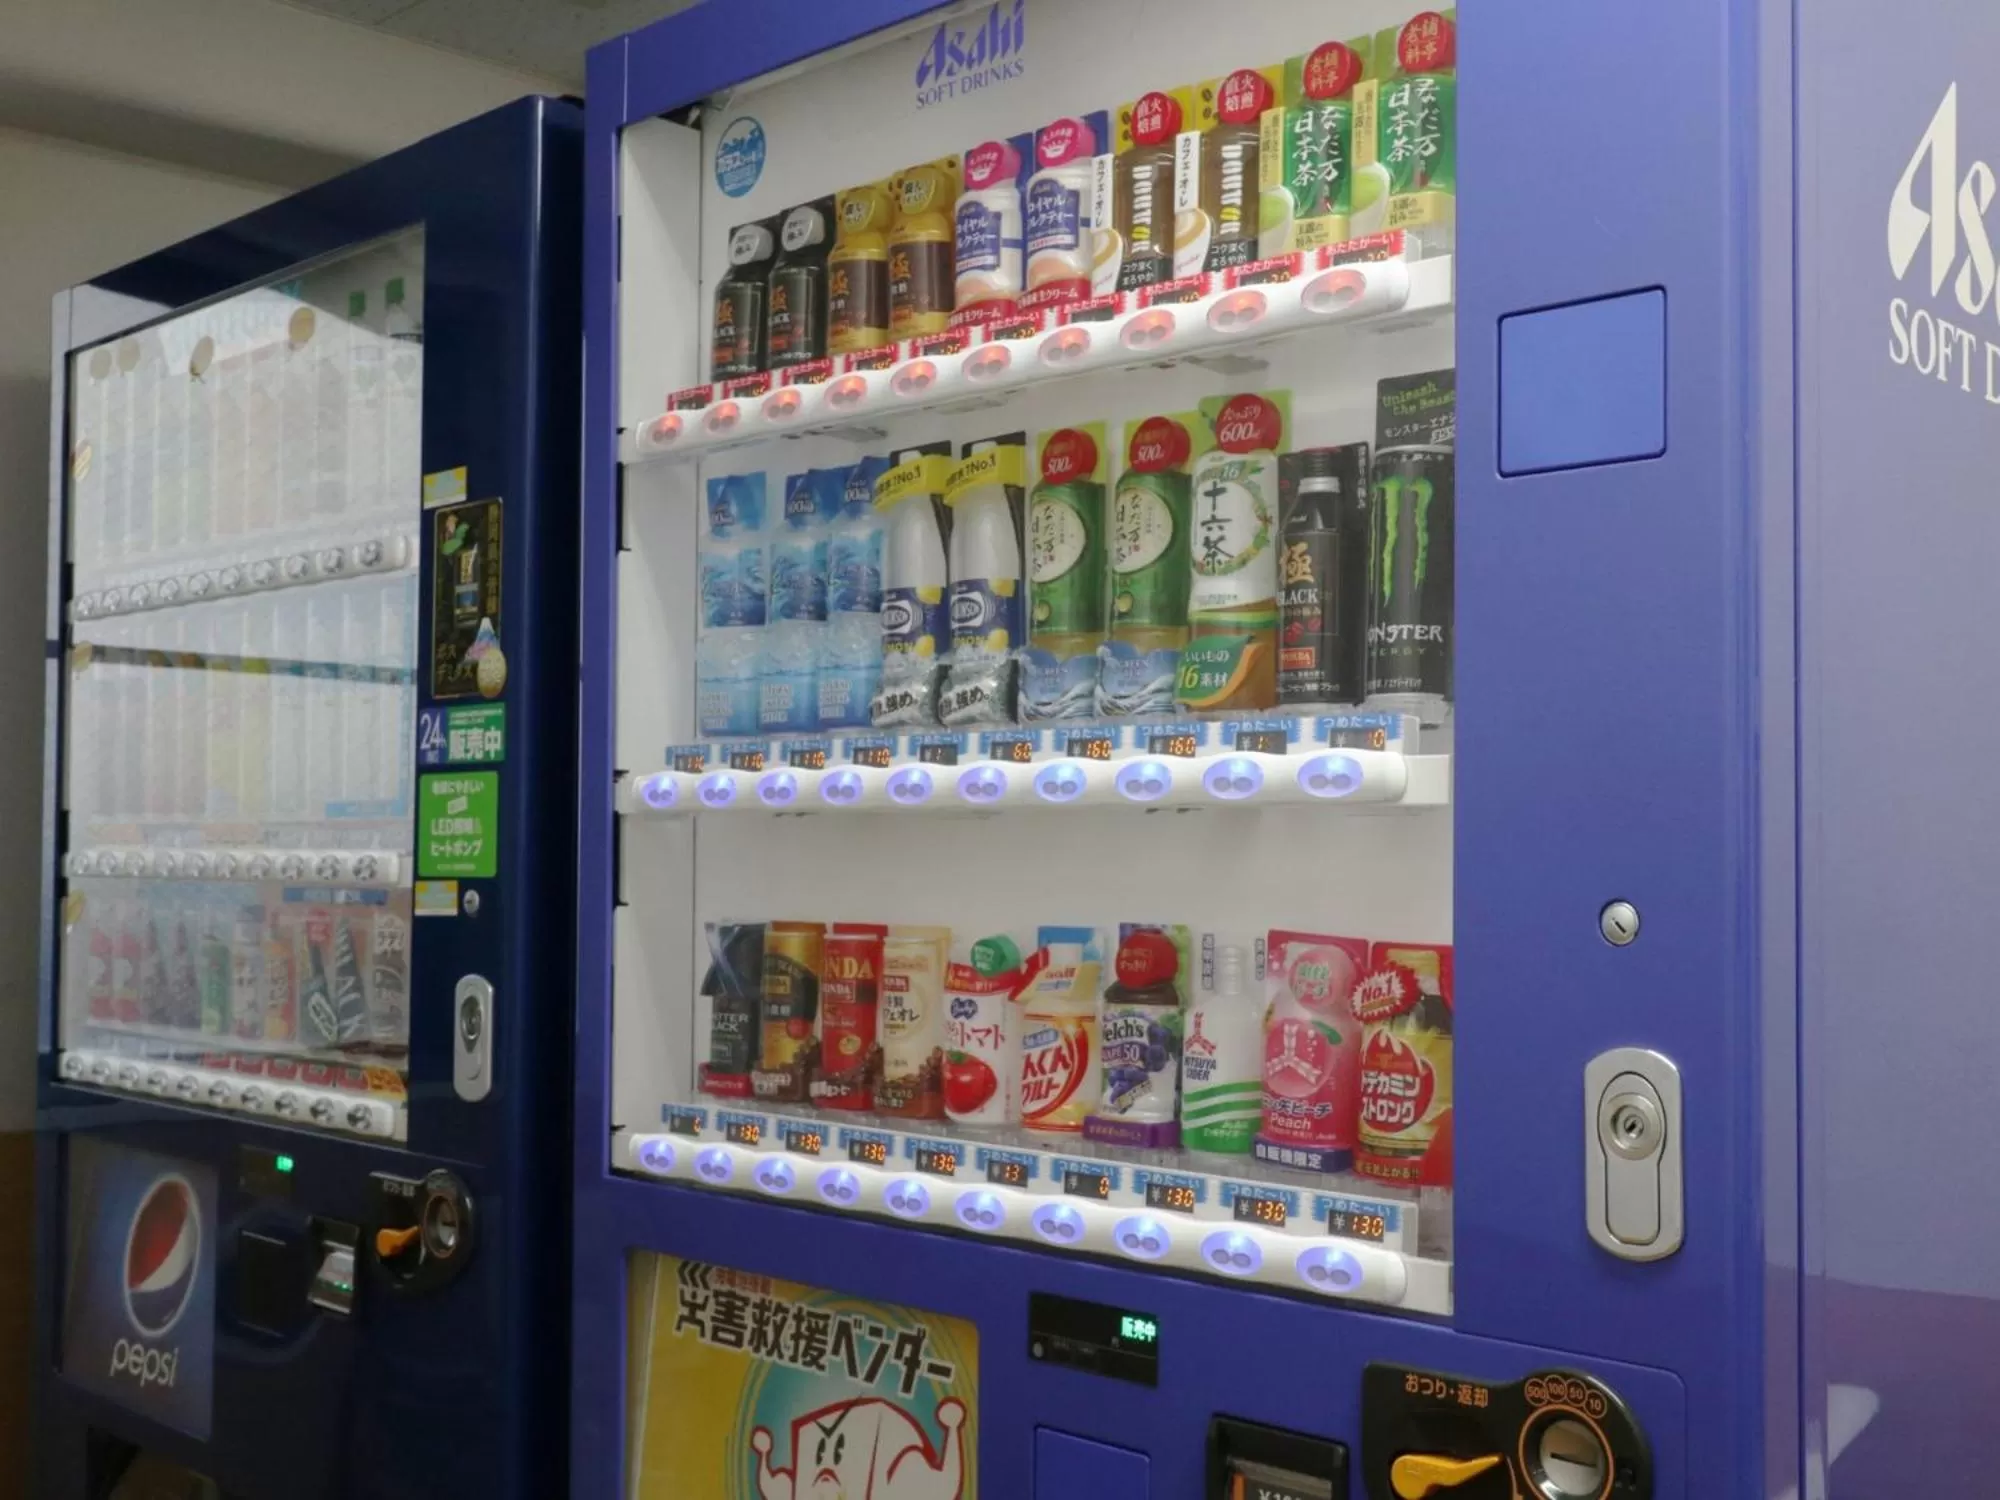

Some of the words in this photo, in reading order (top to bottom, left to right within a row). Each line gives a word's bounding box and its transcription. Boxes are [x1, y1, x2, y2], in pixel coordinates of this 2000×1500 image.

[915, 0, 1025, 88] Asahi
[915, 81, 954, 111] SOFT
[960, 57, 1025, 95] DRINKS
[1888, 296, 1977, 393] SOFT
[1201, 481, 1234, 574] 十六茶
[449, 725, 502, 761] 販売中
[430, 838, 484, 858] ヒートポンプ
[1103, 1020, 1145, 1042] elch's
[1123, 1045, 1141, 1062] 50
[1270, 1112, 1312, 1130] Peach
[1141, 1171, 1201, 1189] つめた〜い
[1166, 1187, 1195, 1207] 130
[1229, 1185, 1292, 1203] つめた〜い
[1255, 1200, 1287, 1222] 130
[1323, 1198, 1392, 1217] つめた〜い
[1352, 1216, 1385, 1237] 130
[675, 1259, 954, 1396] 災害救援ベンダー
[1121, 1315, 1157, 1342] 販売中
[109, 1336, 179, 1388] pepsi
